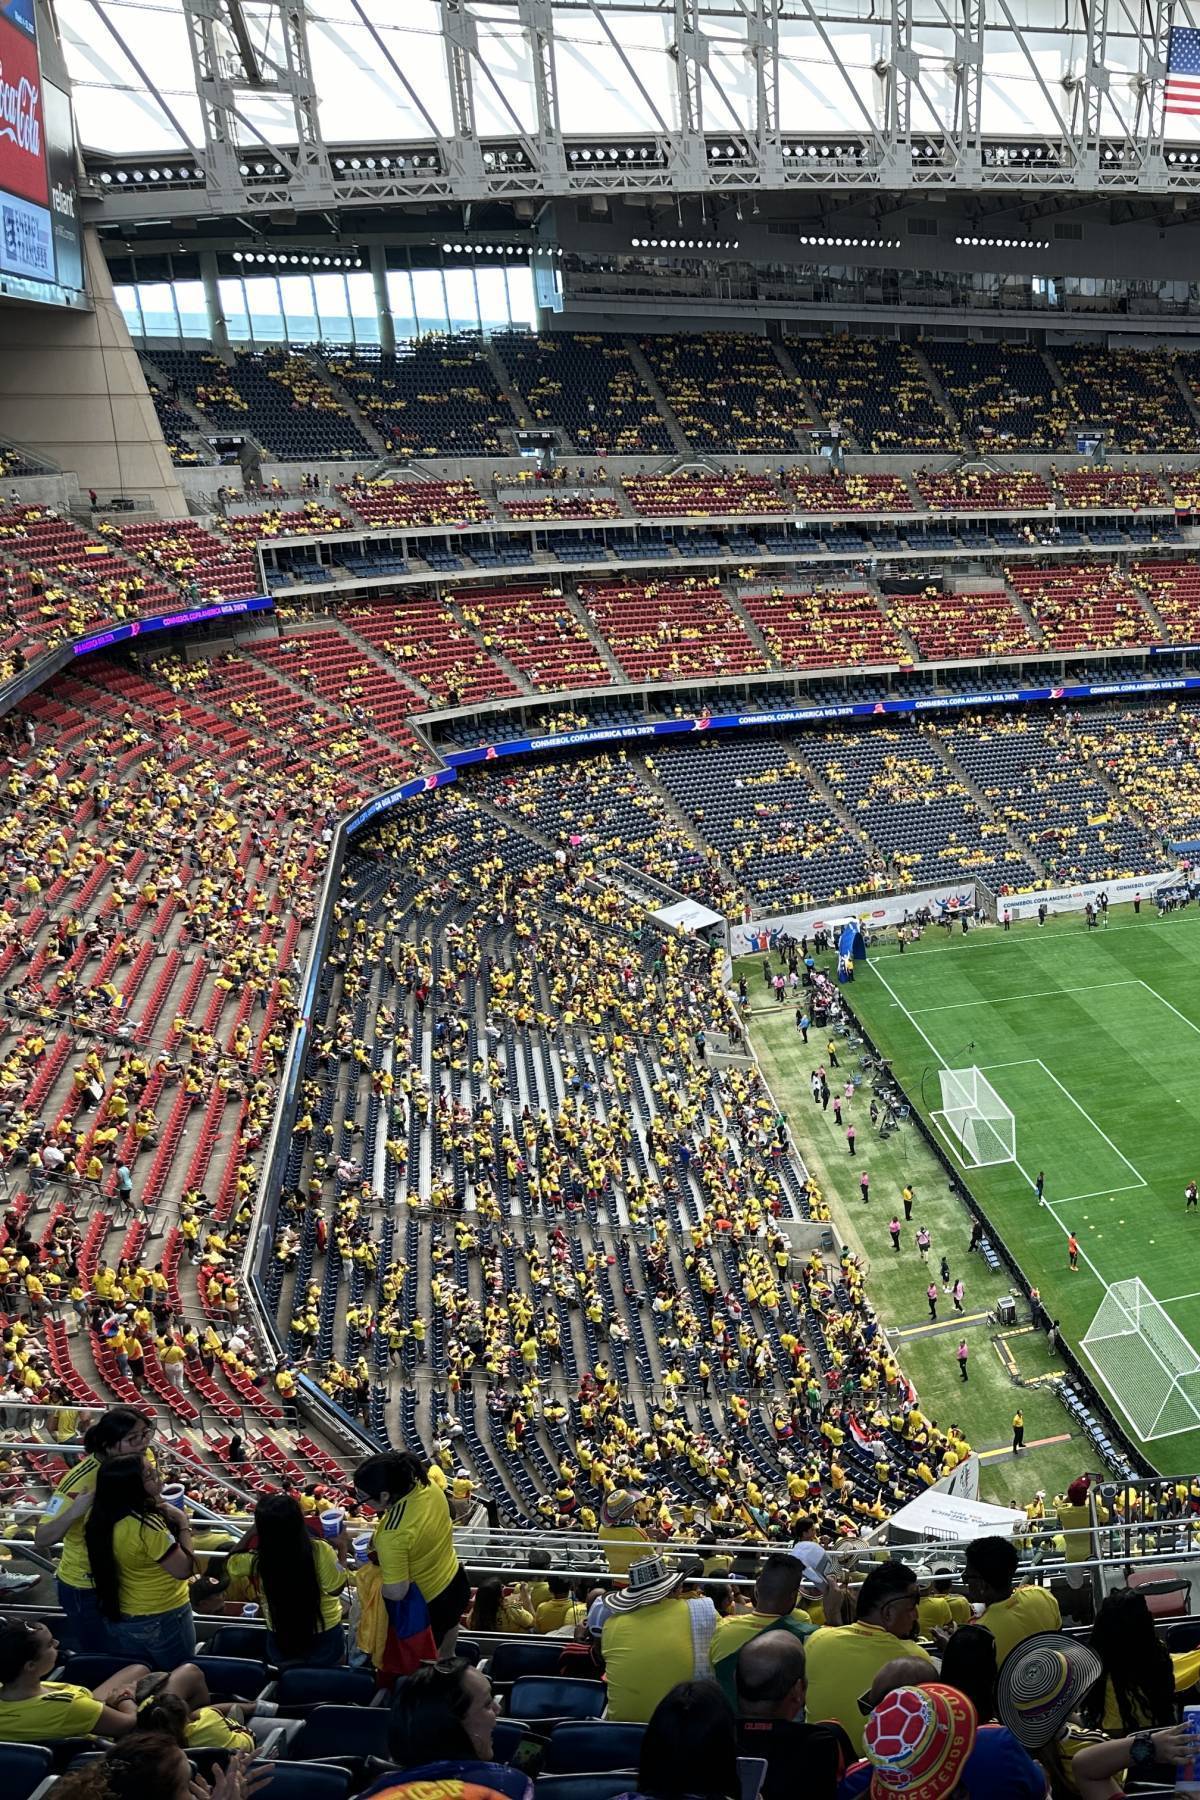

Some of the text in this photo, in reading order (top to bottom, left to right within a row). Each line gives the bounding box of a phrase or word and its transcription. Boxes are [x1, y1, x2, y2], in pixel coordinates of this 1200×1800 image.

[915, 698, 948, 708] CONMEBOL
[950, 697, 966, 705] COPA
[966, 695, 992, 703] AMERICA
[739, 714, 776, 724] CONMEBOL
[777, 713, 794, 721] COPA
[795, 710, 823, 719] AMERICA
[825, 709, 837, 717] USA
[531, 727, 655, 749] CONMEBOL COPA AMERICA USA 2024
[1004, 900, 1032, 908] CONMEBOL
